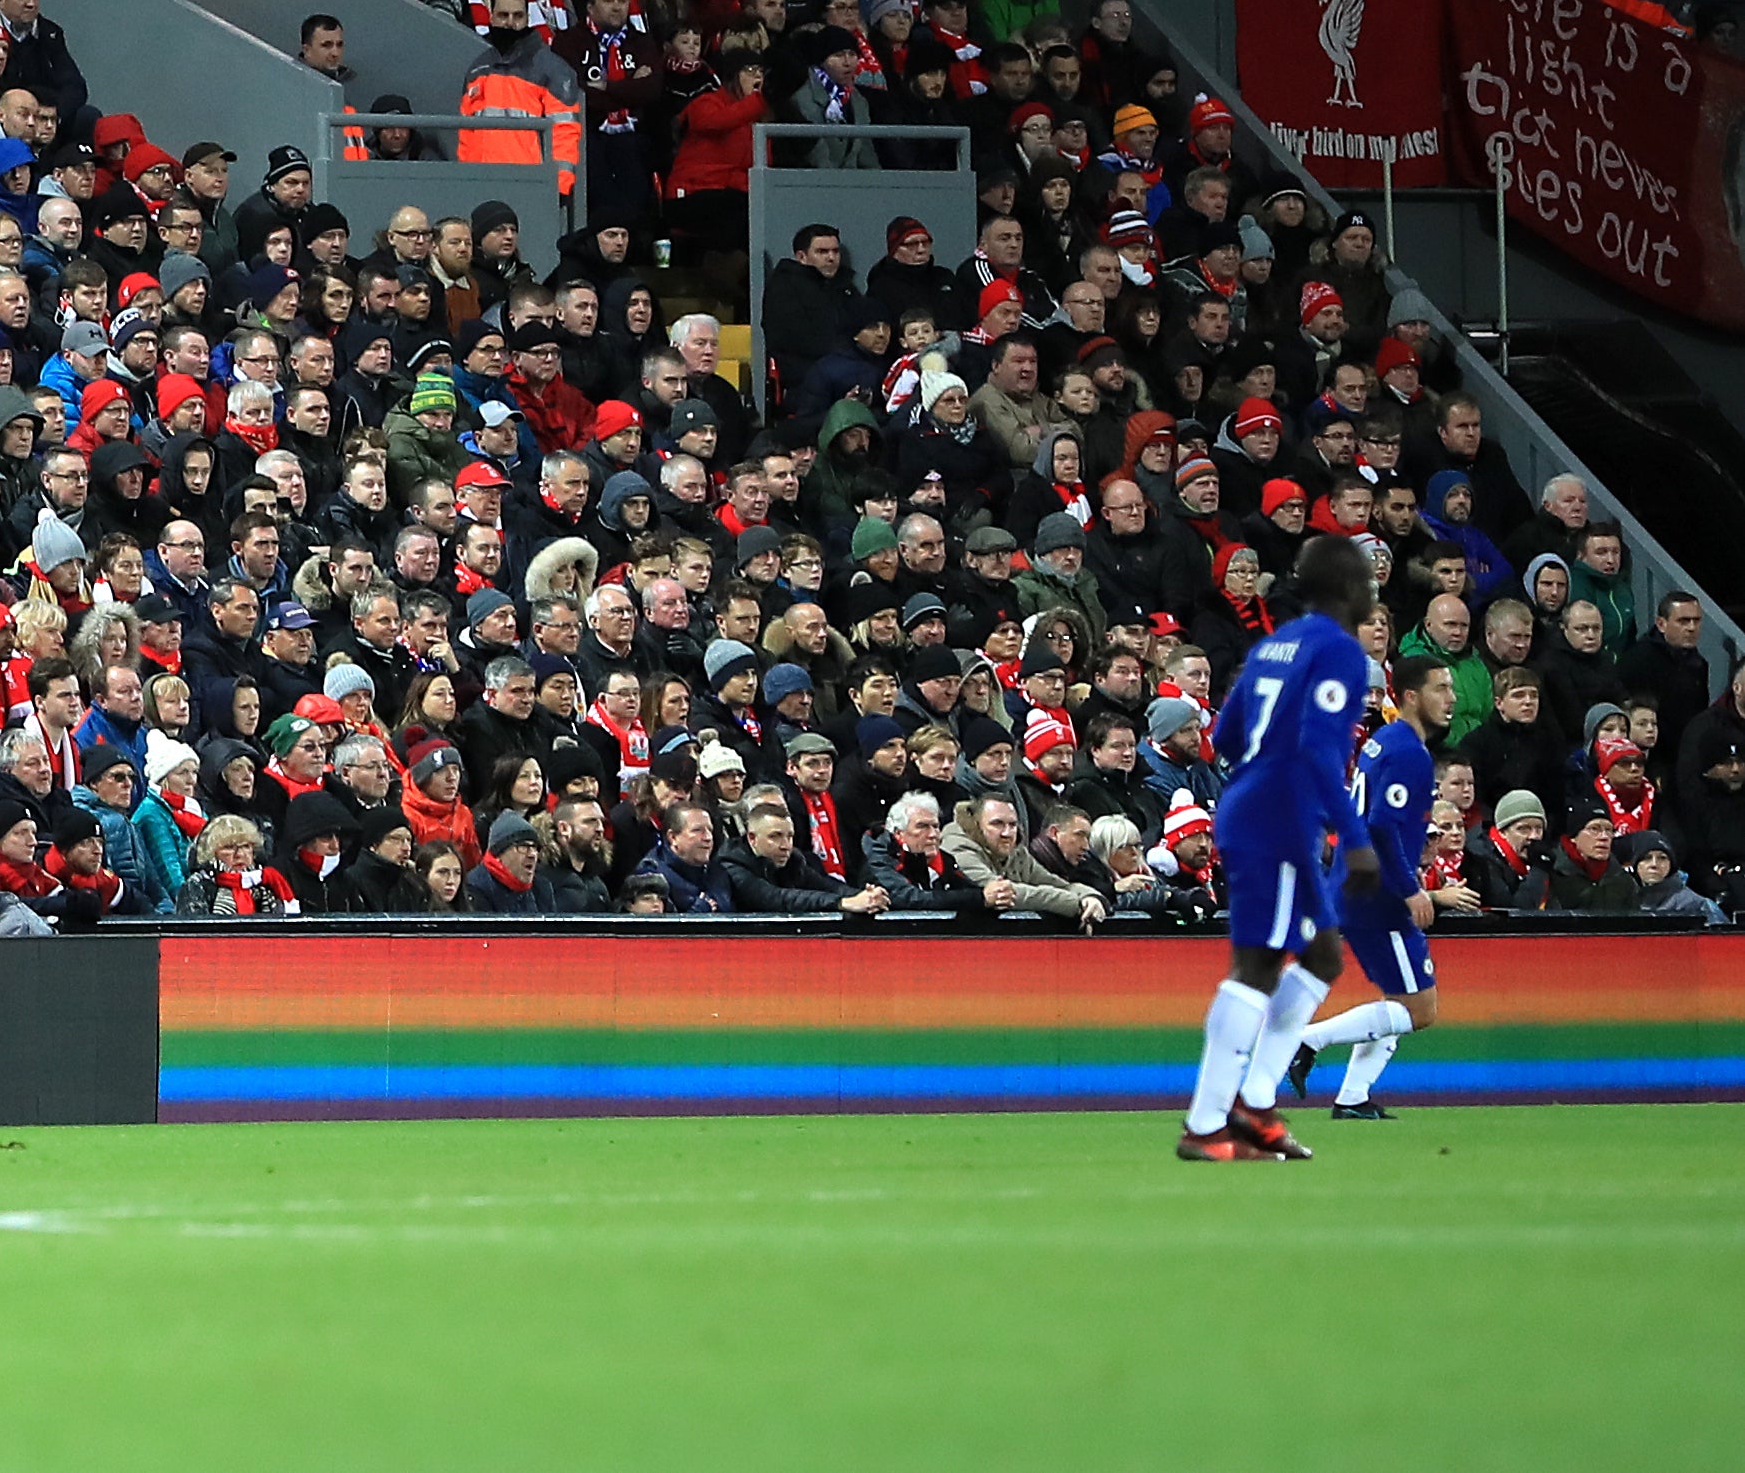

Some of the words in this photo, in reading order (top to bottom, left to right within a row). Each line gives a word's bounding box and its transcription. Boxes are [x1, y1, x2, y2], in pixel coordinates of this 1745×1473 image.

[1604, 7, 1640, 72] is
[1662, 42, 1693, 96] a
[1312, 126, 1344, 158] bird
[1346, 133, 1365, 159] on
[1575, 128, 1680, 221] never
[1596, 212, 1680, 287] out
[1245, 677, 1285, 764] 7
